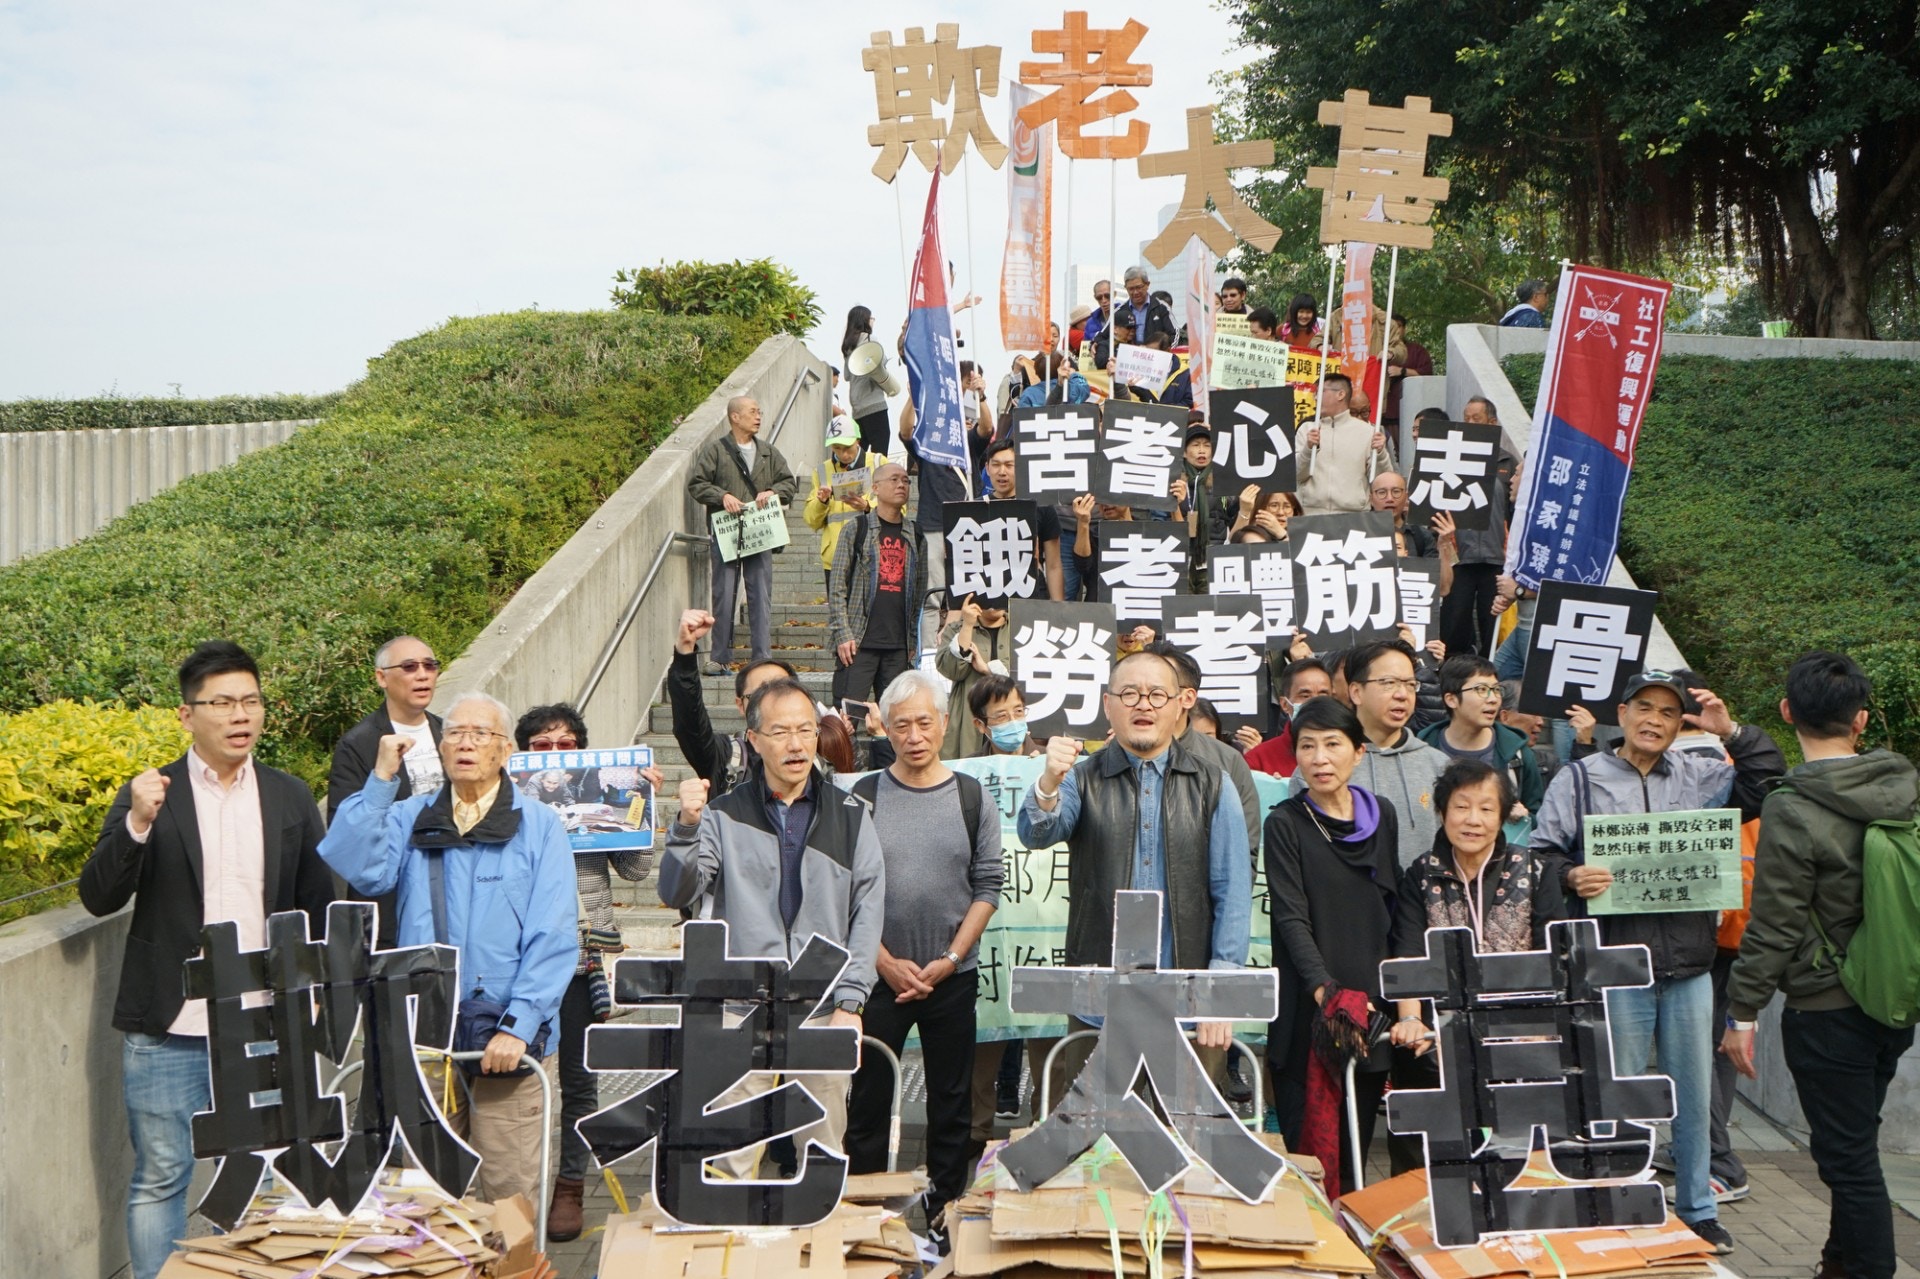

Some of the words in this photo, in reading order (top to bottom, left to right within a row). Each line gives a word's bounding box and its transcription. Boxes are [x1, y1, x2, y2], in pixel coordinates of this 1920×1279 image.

[861, 22, 1010, 184] 欺
[1018, 11, 1154, 160] 老
[1138, 104, 1284, 270] 太
[1306, 88, 1454, 250] 甚
[1613, 296, 1655, 453] 社工復興運動
[1019, 411, 1095, 493] 苦
[1212, 400, 1293, 480] 心
[1409, 430, 1494, 512] 志
[946, 516, 1037, 599] 餓
[1528, 455, 1574, 575] 邵家臻
[1551, 463, 1591, 580] 立法會議員辦事處
[1294, 529, 1397, 636] 筋
[1014, 619, 1112, 726] 勞
[1536, 598, 1643, 701] 骨
[1591, 822, 1651, 838] 林鄭涼薄
[1658, 818, 1734, 835] 撕毀安全網
[1592, 841, 1652, 857] 忽然年輕
[1659, 837, 1735, 854] 捱多五年窮
[1640, 886, 1693, 902] 大聯盟
[182, 901, 482, 1234] 欺
[574, 919, 863, 1228] 老
[998, 889, 1289, 1205] 太
[1379, 918, 1678, 1250] 甚
